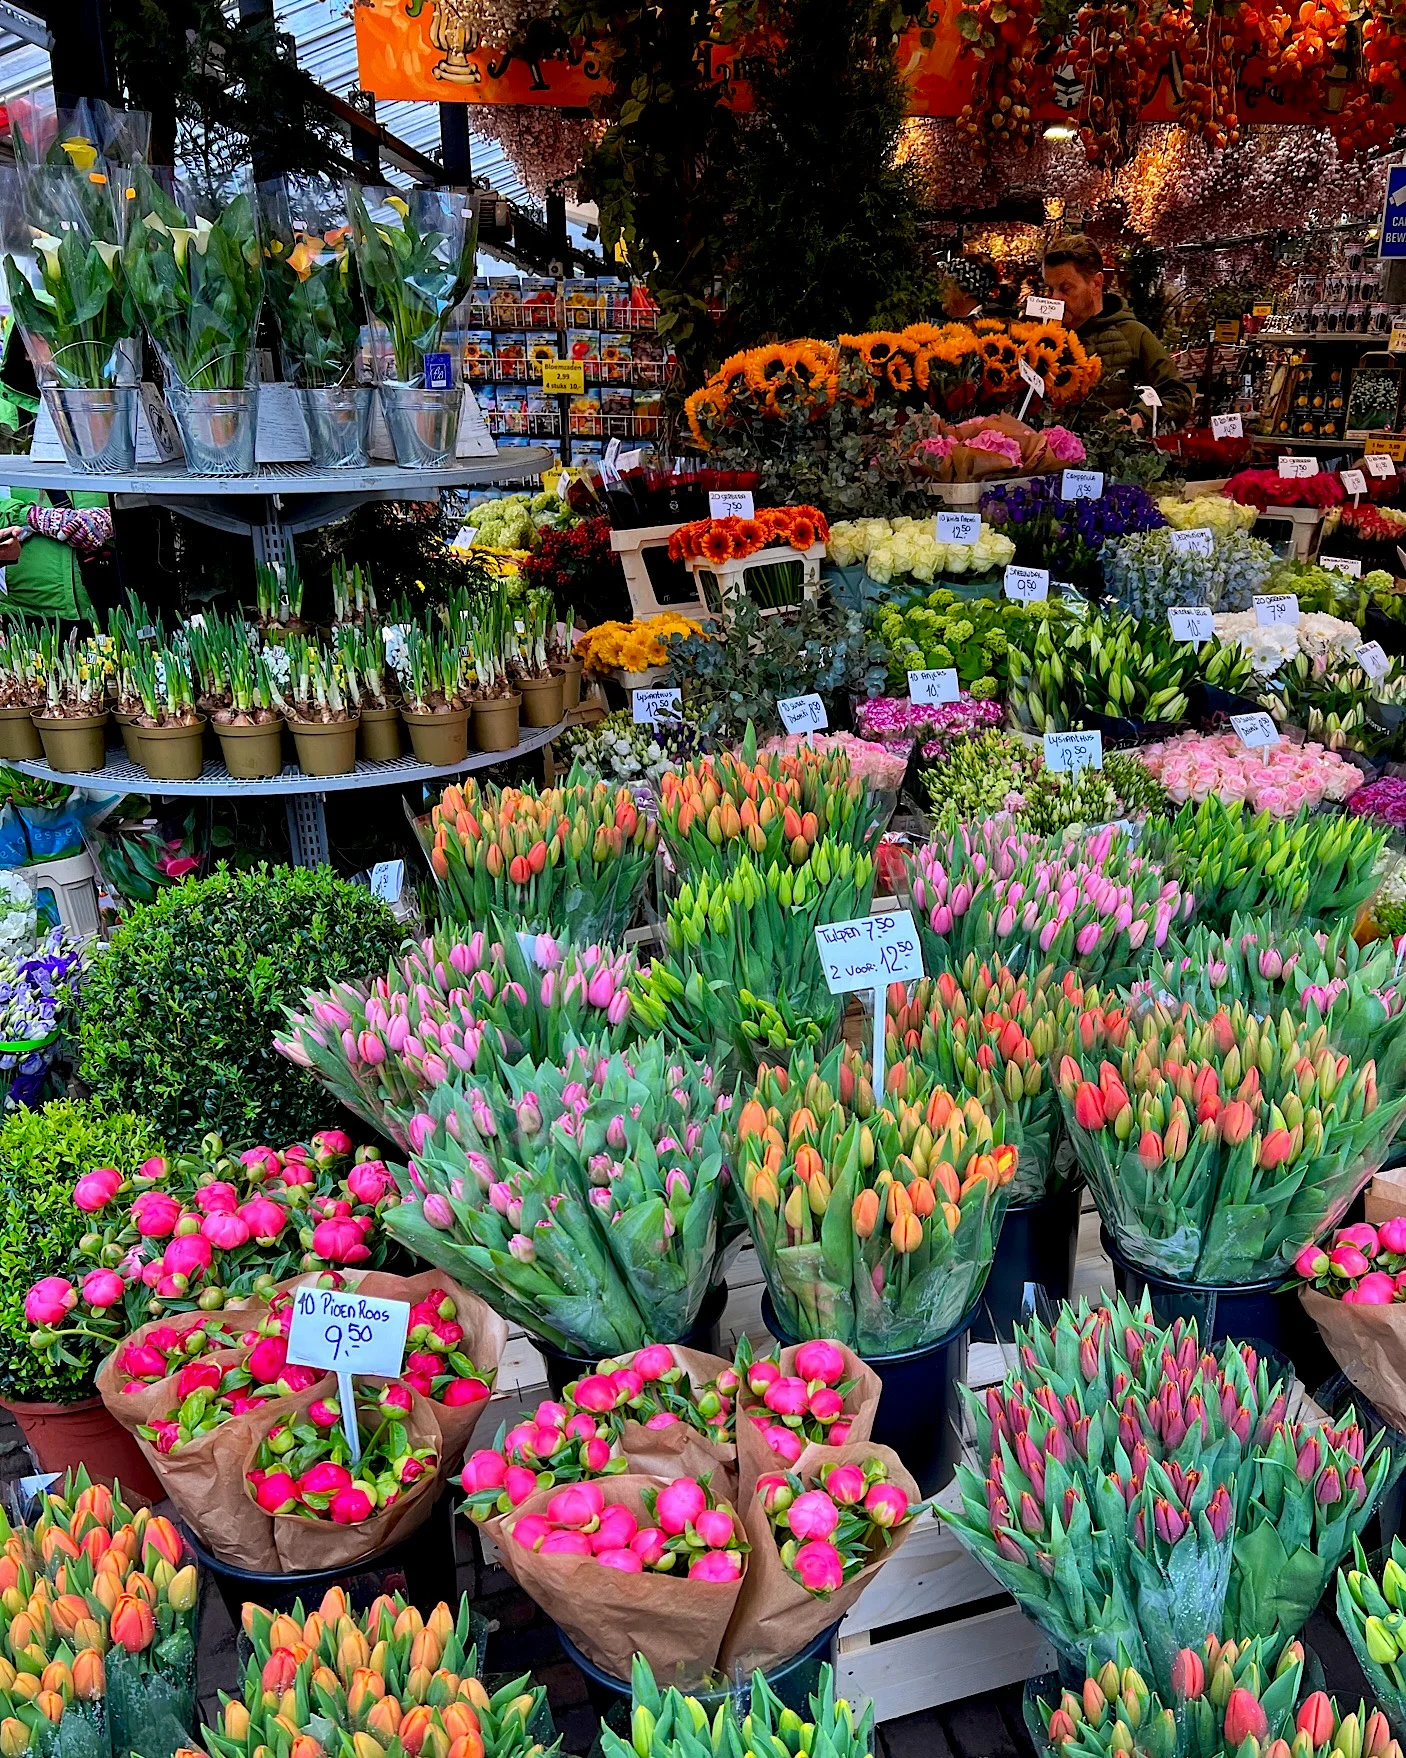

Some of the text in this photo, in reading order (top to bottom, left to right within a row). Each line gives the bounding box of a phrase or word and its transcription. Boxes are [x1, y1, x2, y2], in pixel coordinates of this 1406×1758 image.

[1392, 216, 1406, 227] CA
[1385, 232, 1406, 243] BEW
[544, 363, 582, 371] Bloemzaden
[830, 965, 842, 980] 2
[297, 1292, 315, 1315] 10
